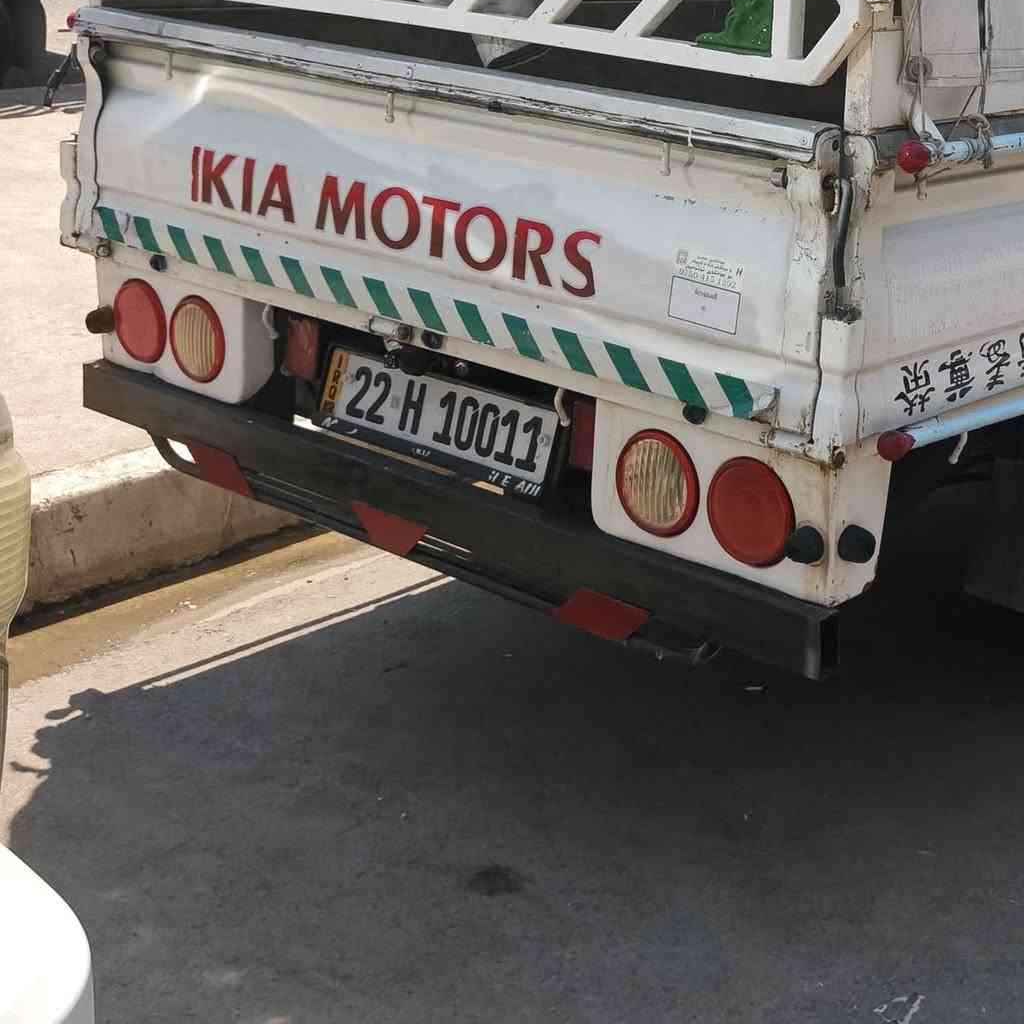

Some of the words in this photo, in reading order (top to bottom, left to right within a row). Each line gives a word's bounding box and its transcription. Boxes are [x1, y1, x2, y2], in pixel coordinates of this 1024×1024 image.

[314, 174, 603, 298] MOTORS
[345, 366, 392, 425] 22
[398, 379, 428, 435] H
[432, 391, 544, 473] 10011
